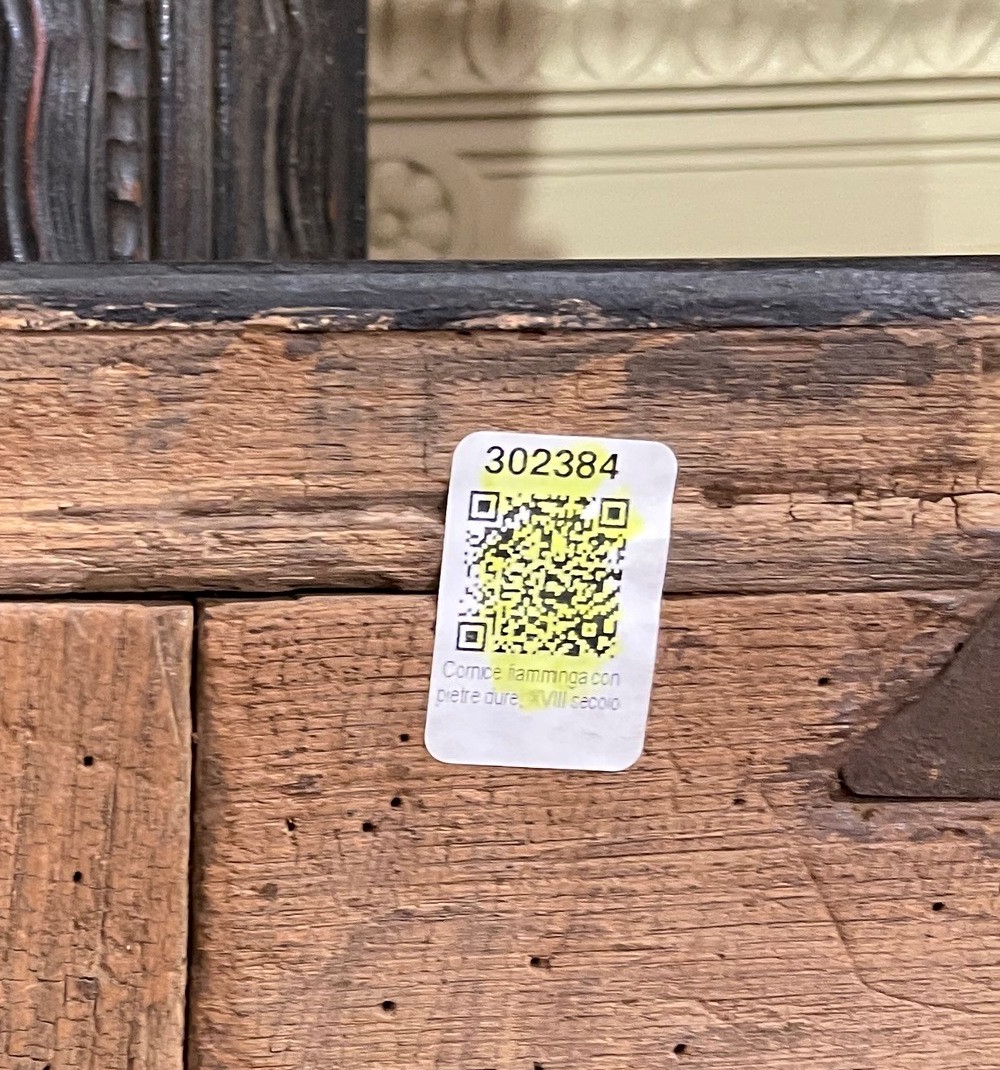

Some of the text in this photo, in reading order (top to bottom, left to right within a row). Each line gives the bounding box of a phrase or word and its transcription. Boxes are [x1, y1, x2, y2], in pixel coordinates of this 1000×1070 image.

[485, 446, 619, 479] 302384
[443, 660, 502, 680] Cornice
[591, 671, 621, 687] con
[436, 687, 481, 707] pietre
[571, 693, 621, 711] secolo
